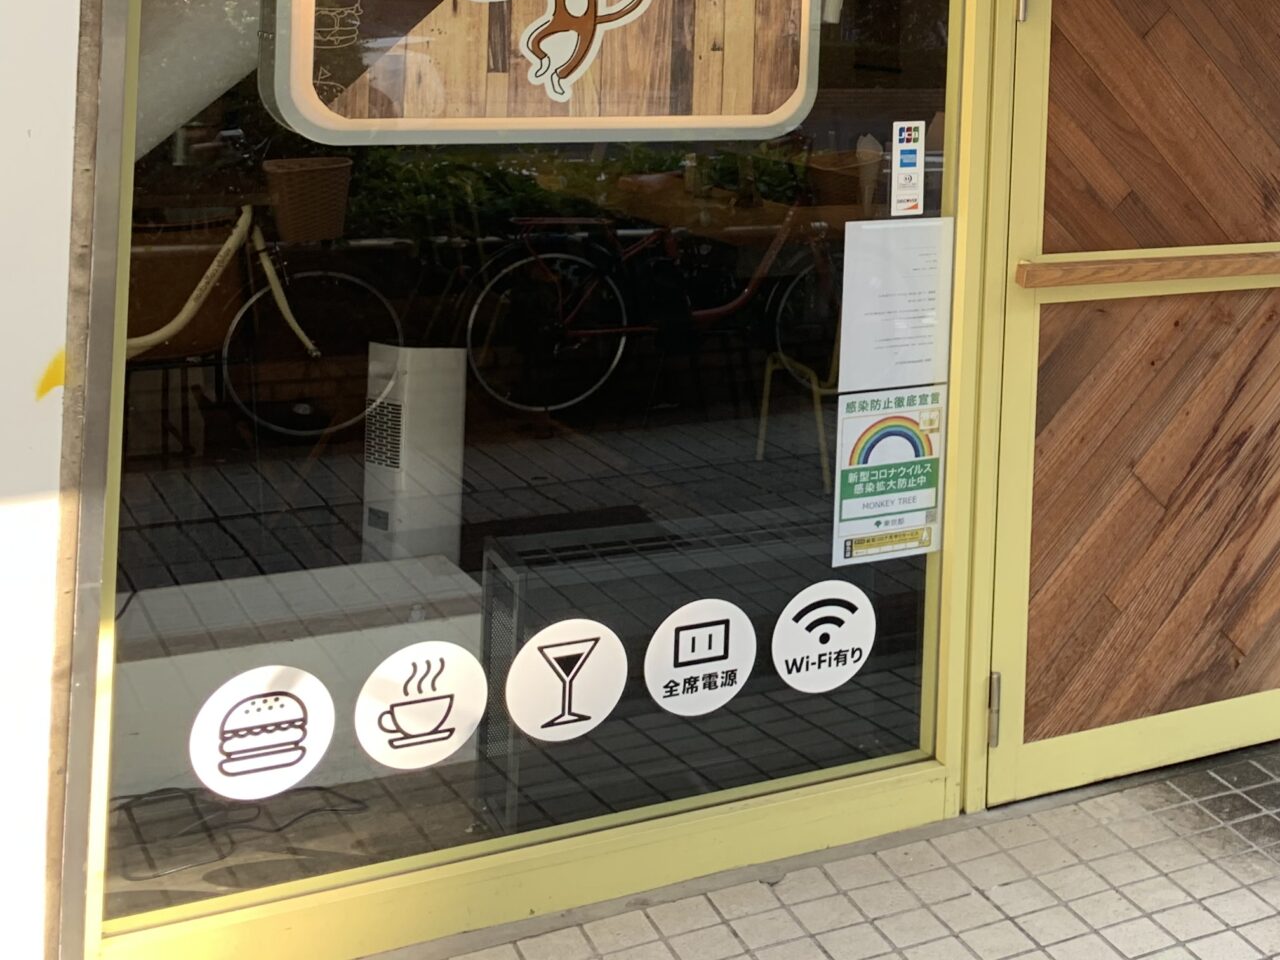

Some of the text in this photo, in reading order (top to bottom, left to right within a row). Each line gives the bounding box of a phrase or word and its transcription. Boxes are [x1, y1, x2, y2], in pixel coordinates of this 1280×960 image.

[845, 392, 940, 413] 感染防止徹底宣言
[848, 463, 933, 483] 新型コロナウイルス
[862, 495, 918, 510] MONKEY TREE
[785, 646, 863, 676] Wi-Fi有り
[662, 668, 739, 699] 全席電源
